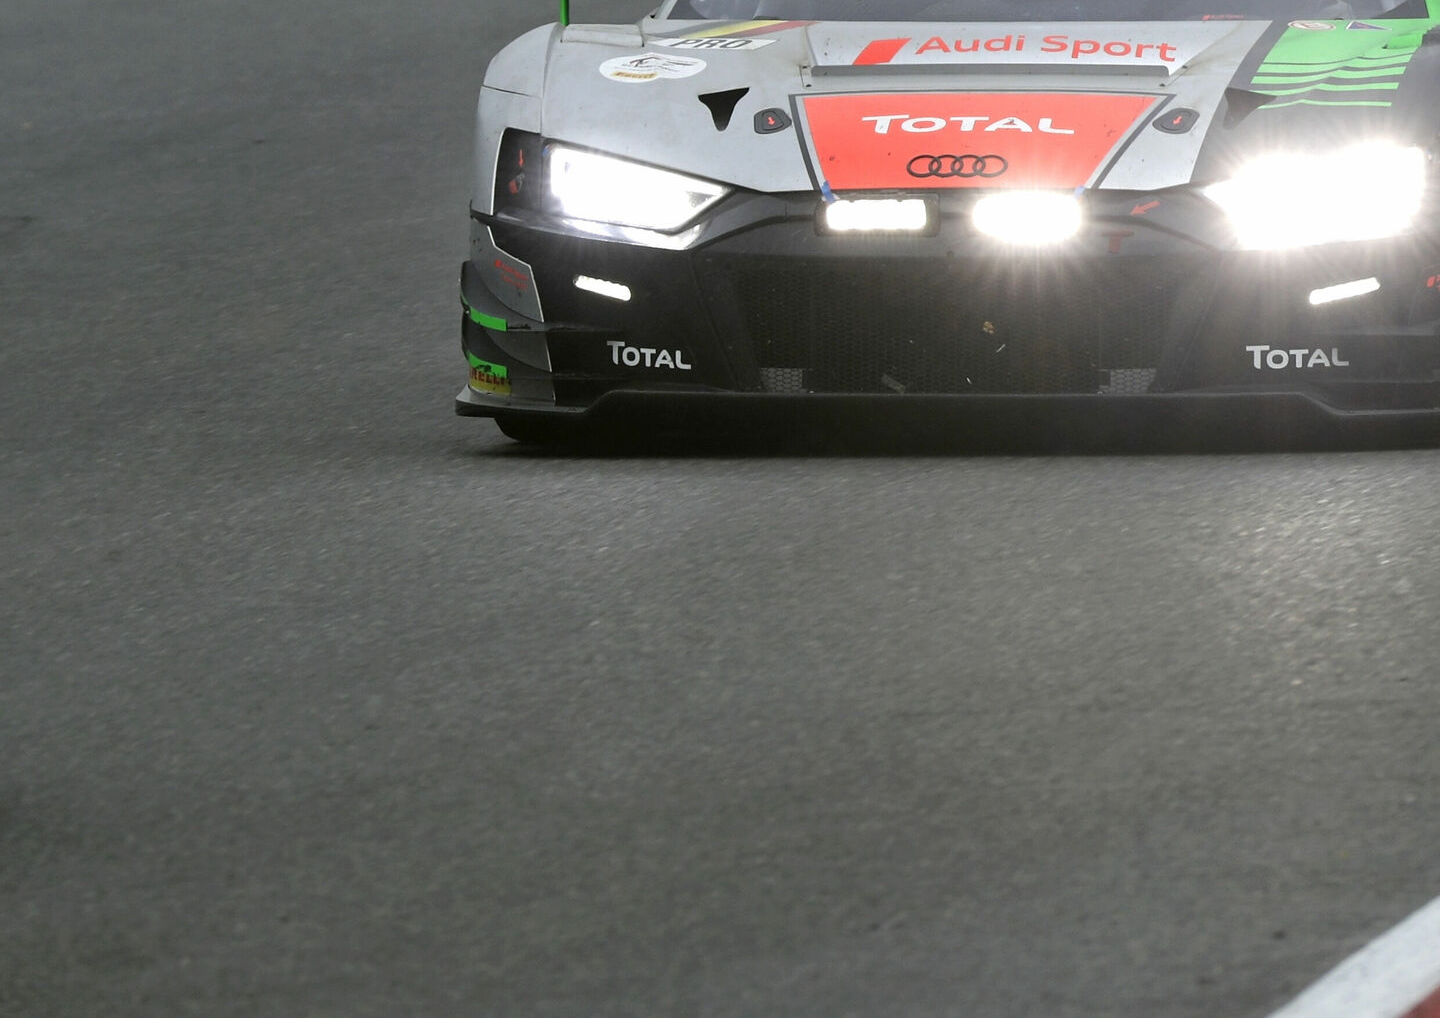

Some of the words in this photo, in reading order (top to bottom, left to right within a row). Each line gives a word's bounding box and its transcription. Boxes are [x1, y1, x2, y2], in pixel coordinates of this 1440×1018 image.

[670, 38, 752, 49] PRO
[915, 34, 1026, 56] Audi
[1040, 35, 1178, 63] Sport
[861, 114, 1075, 135] TOTAL
[606, 340, 692, 370] TOTAL
[1246, 344, 1350, 370] TOTAL
